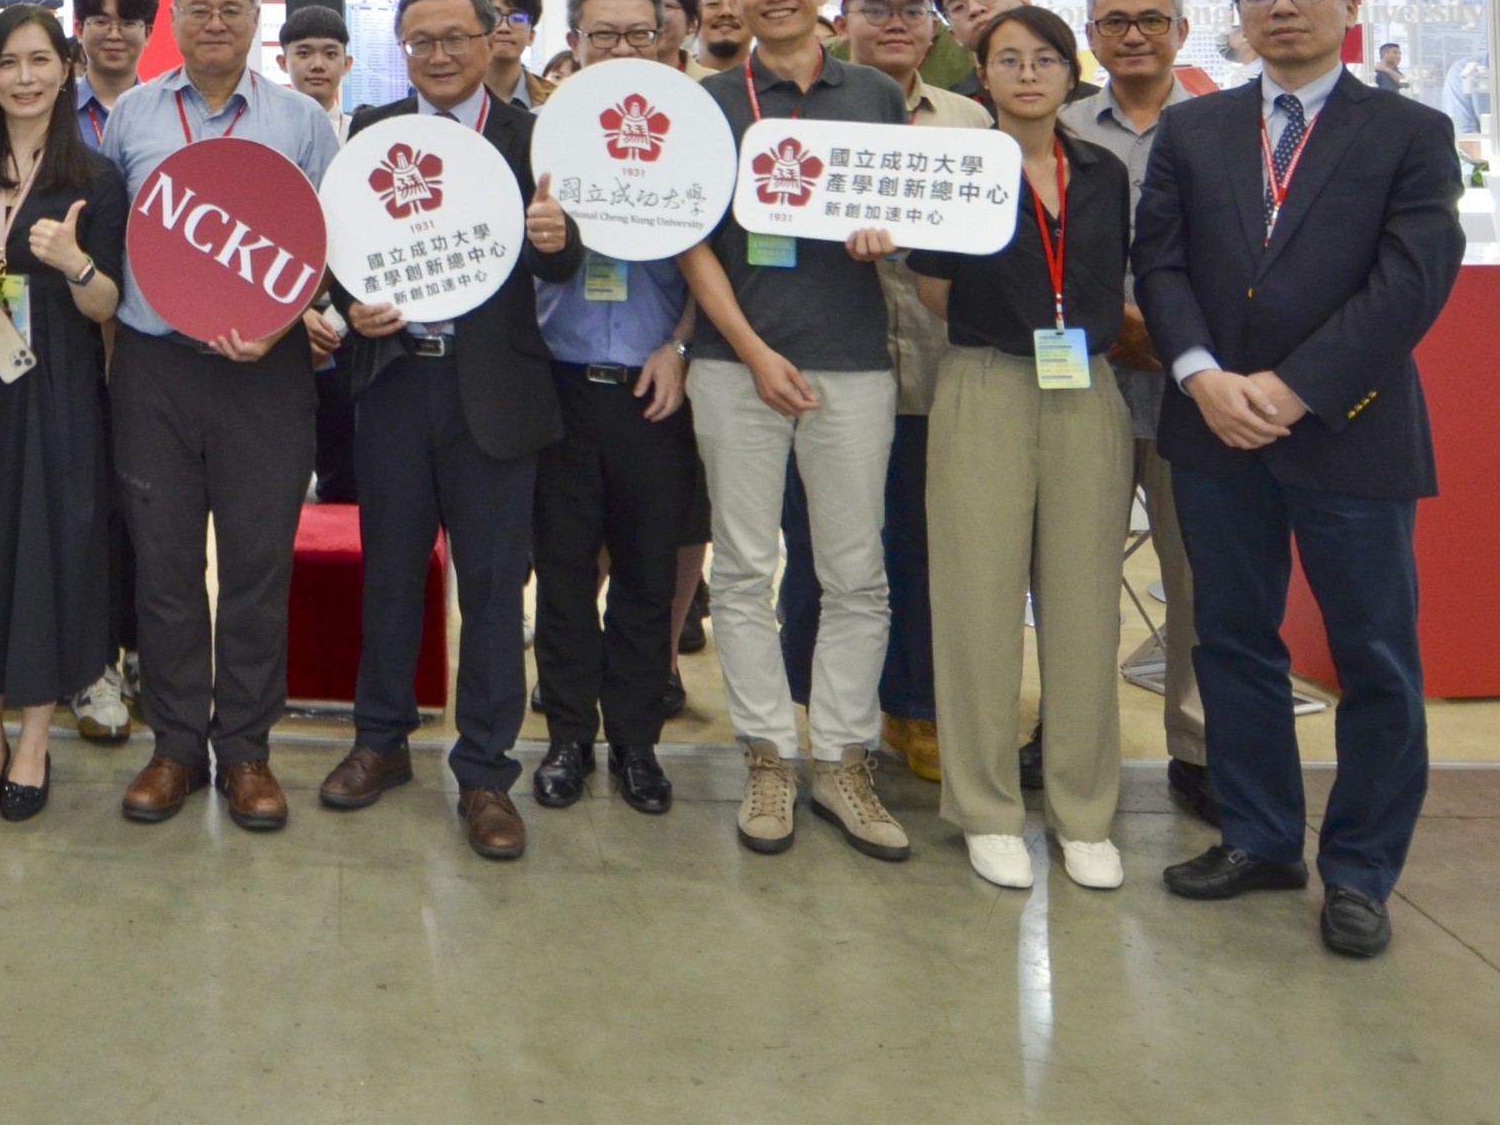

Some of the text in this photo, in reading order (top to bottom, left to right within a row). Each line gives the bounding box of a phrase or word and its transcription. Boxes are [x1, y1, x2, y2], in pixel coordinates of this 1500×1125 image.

[622, 168, 645, 177] 1931
[829, 147, 984, 176] 國立成功大學
[559, 177, 707, 217] 國立成功大學
[826, 172, 1009, 206] 產學創新總中心
[409, 220, 435, 234] 1931
[600, 212, 629, 224] Cheng
[630, 215, 655, 226] Kung
[657, 217, 705, 230] University
[769, 212, 793, 223] 1931
[824, 201, 944, 226] 新創加速中心
[138, 171, 317, 306] NCKU
[367, 223, 491, 268] 國立成功大學
[363, 241, 507, 294] 產學創新總中心
[393, 269, 488, 306] 新創加速中心
